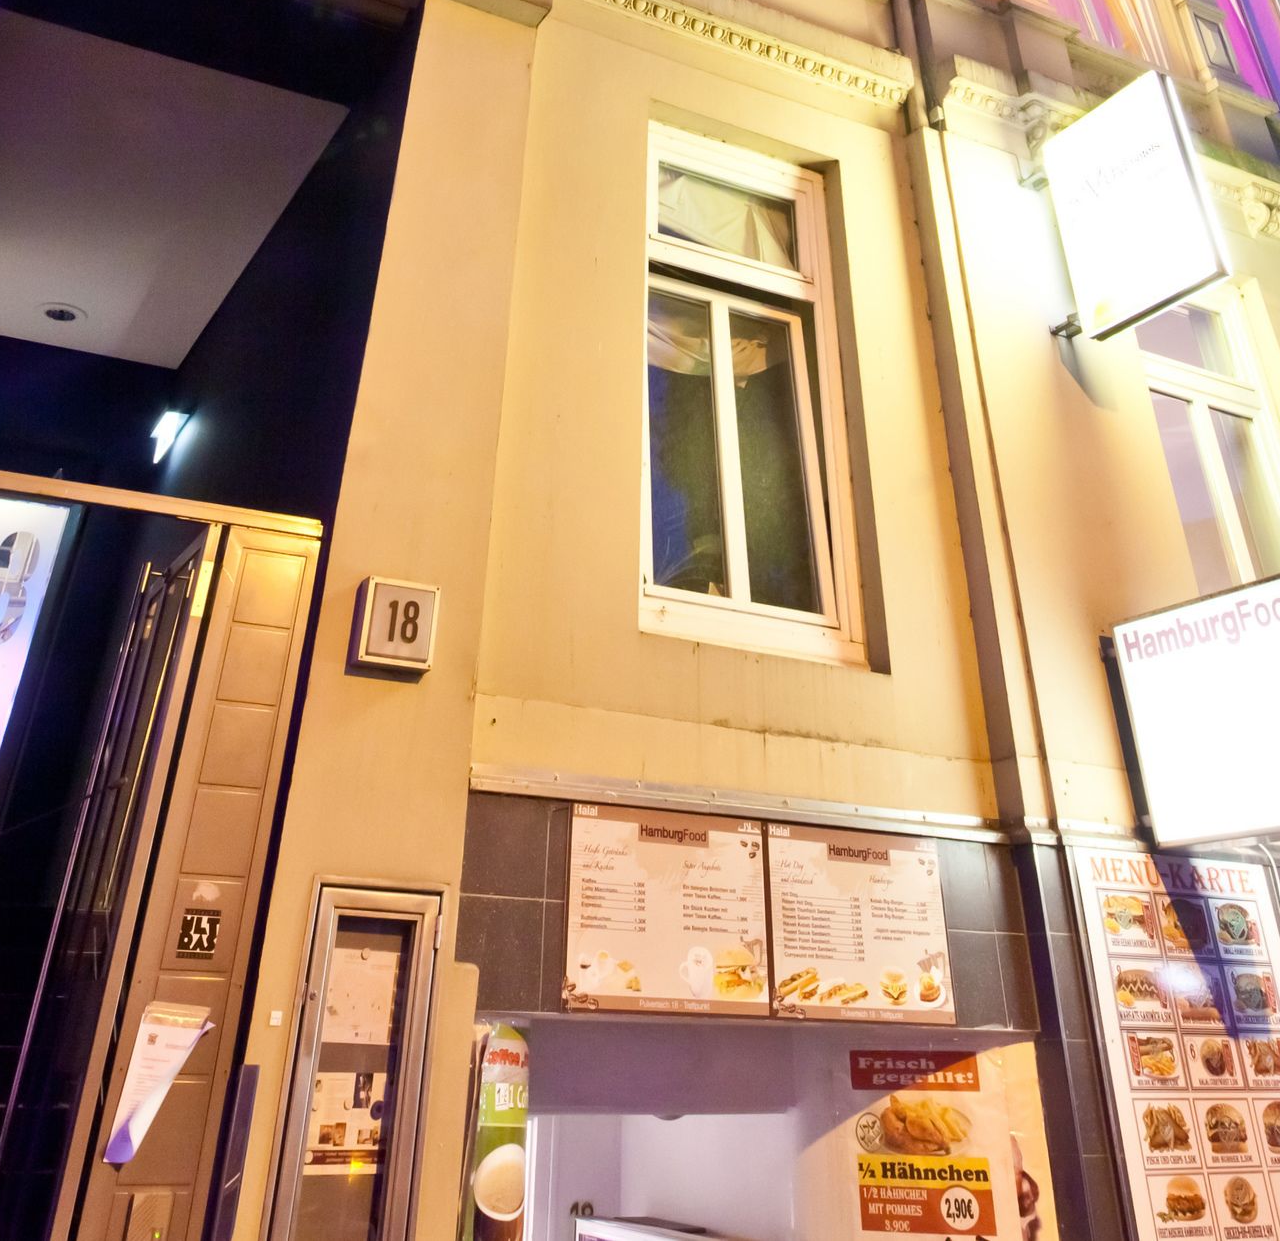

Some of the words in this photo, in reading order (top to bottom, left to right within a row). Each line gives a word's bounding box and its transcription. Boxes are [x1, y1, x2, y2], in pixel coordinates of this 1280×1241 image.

[387, 600, 420, 644] 18
[574, 803, 598, 816] Halal
[640, 824, 707, 843] HamburgFood
[770, 825, 790, 837] Halal
[828, 844, 888, 861] HamburgFood
[858, 1057, 935, 1070] Frisch
[872, 1071, 974, 1086] gegrillt!
[881, 1161, 989, 1182] Hähnchen
[863, 1187, 878, 1198] 1/2
[868, 1203, 883, 1214] MIT
[886, 1204, 923, 1216] POMMES
[945, 1198, 975, 1223] 2,90€
